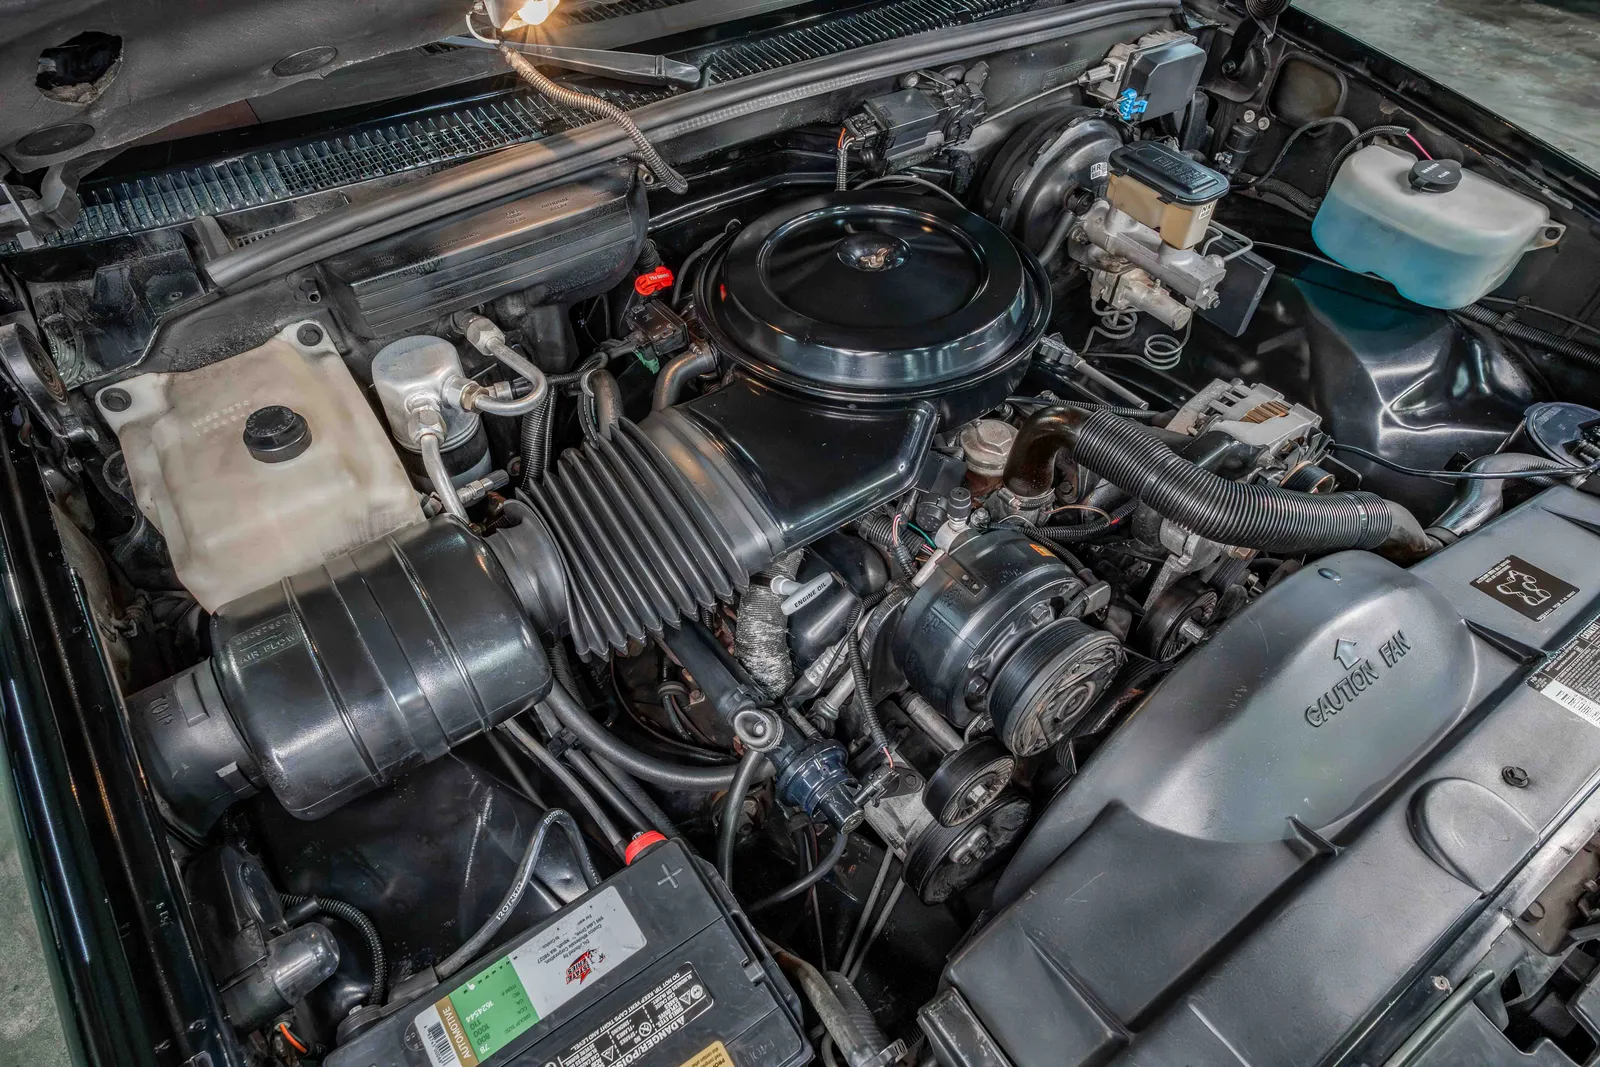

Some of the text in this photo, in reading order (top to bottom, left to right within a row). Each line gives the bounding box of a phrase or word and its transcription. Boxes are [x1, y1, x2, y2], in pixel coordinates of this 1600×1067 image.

[792, 581, 827, 607] ENGINE OIL
[1304, 630, 1411, 727] CAUTION FAN
[585, 920, 596, 929] Lake
[587, 922, 602, 935] Costco
[567, 932, 588, 949] Wholesale
[535, 951, 550, 963] 98027
[661, 977, 673, 987] NOT
[670, 972, 680, 980] DO
[639, 990, 654, 1003] KEEP
[464, 999, 494, 1023] 1624544
[626, 1000, 641, 1012] VENT
[612, 1009, 628, 1022] CAPS
[468, 1018, 482, 1030] 110
[471, 1022, 490, 1038] 1000
[598, 1018, 615, 1032] TIGHT
[442, 1006, 472, 1059] AUTOMOTIVE
[475, 1032, 491, 1045] 800
[587, 1028, 600, 1040] AND
[477, 1041, 491, 1054] 78
[569, 1036, 589, 1052] LEVEL.
